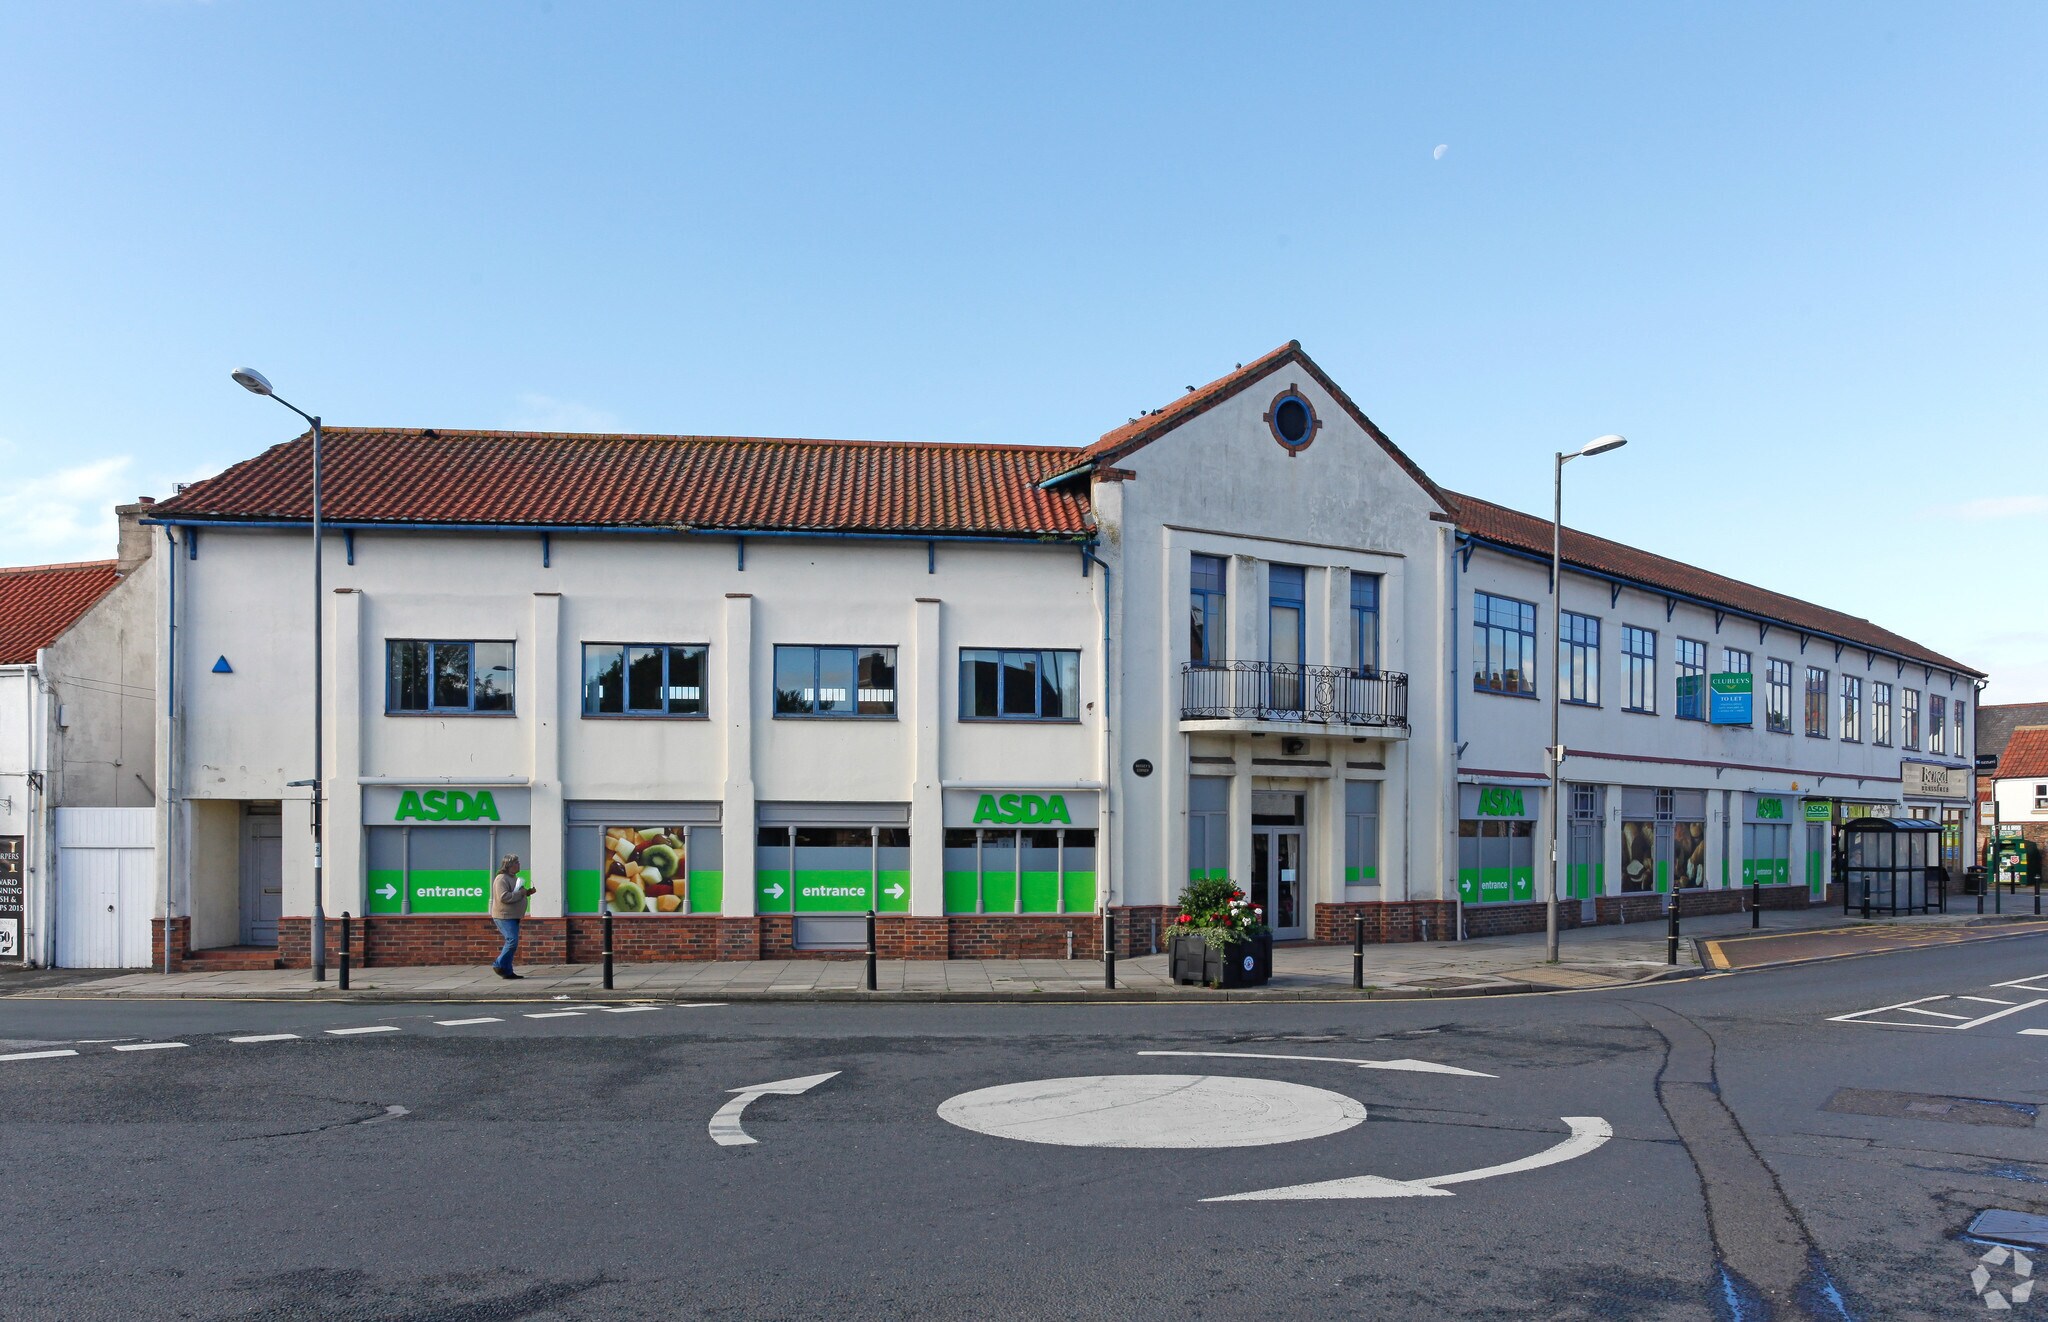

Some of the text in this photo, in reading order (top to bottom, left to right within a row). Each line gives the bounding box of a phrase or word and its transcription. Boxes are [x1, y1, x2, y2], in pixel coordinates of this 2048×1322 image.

[395, 790, 501, 821] ASDA
[1477, 787, 1525, 816] ASDA
[973, 794, 1072, 825] ASDA
[1756, 798, 1784, 819] ASDA
[1806, 805, 1829, 813] ASDA
[1481, 881, 1508, 890] entrance
[416, 886, 483, 898] entrance
[802, 886, 866, 897] entrance
[10, 895, 17, 903] &
[8, 904, 24, 912] 2015
